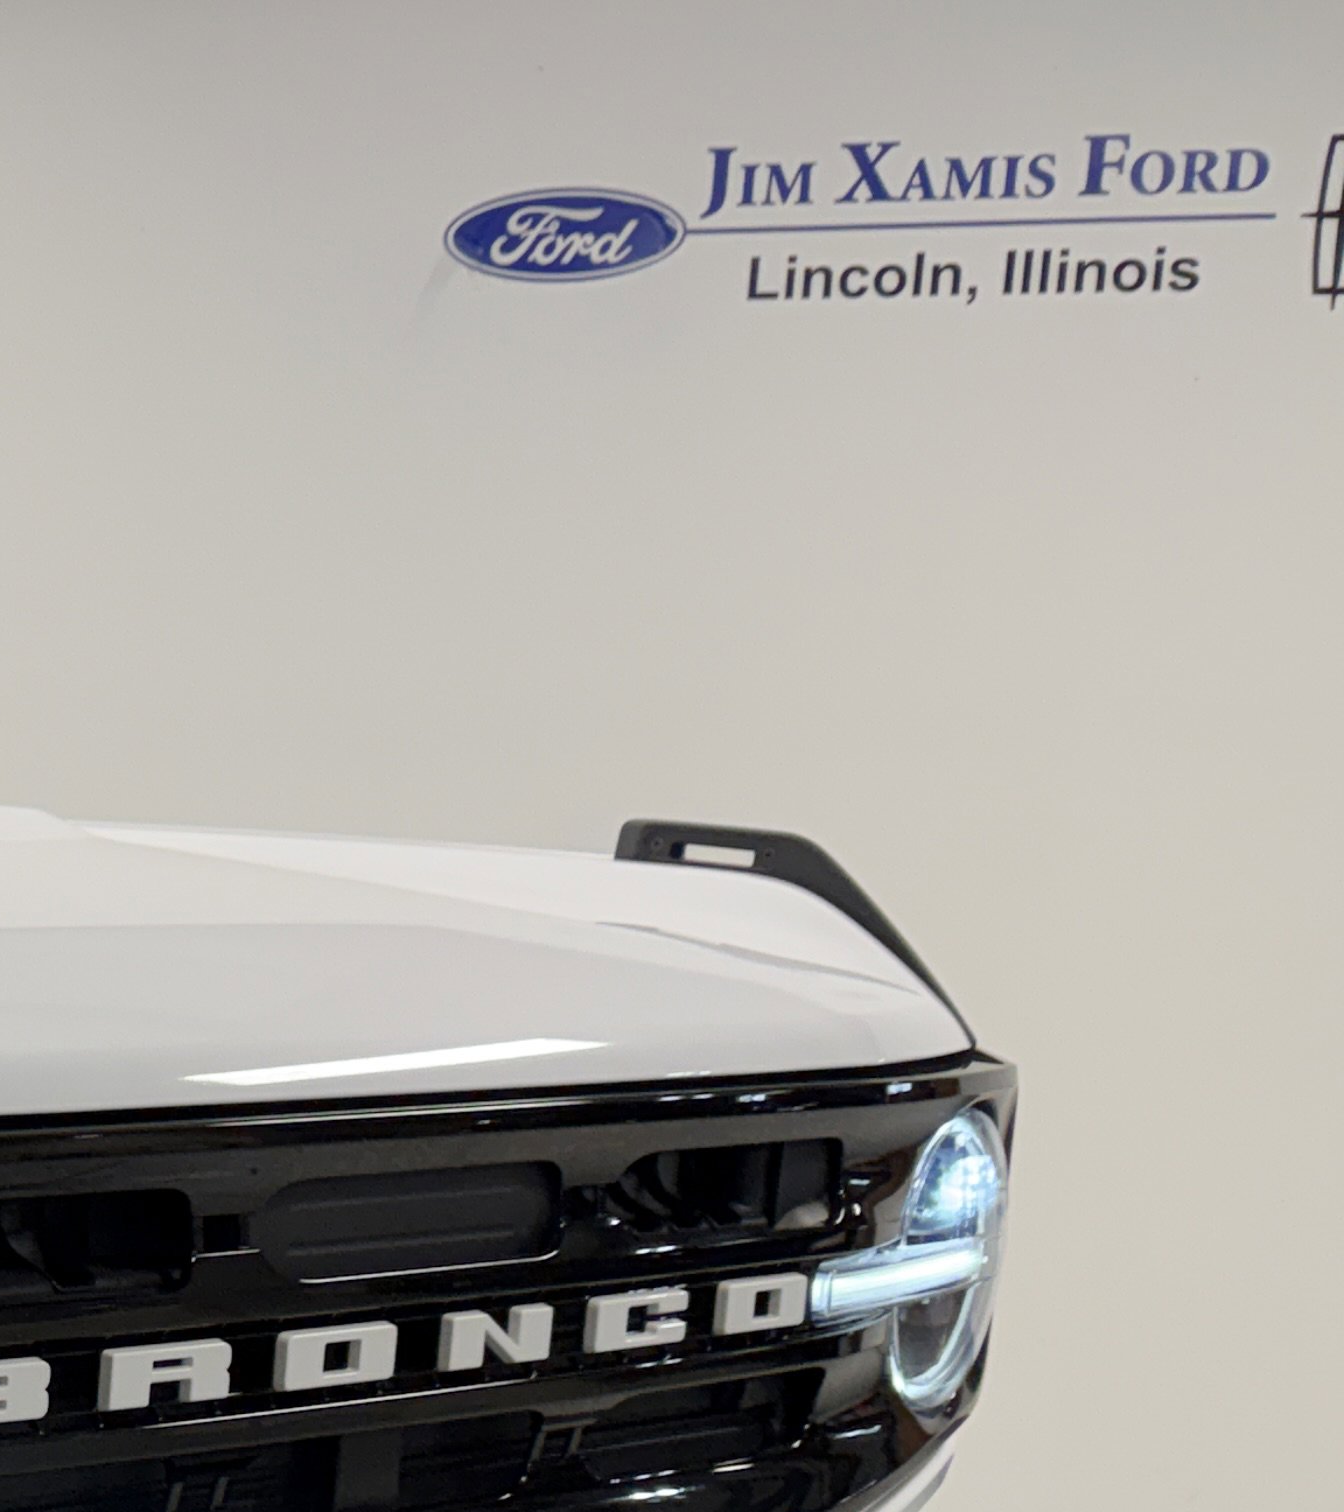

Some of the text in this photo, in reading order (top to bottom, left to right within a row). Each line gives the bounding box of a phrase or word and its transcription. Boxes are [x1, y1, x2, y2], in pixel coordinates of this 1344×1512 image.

[700, 133, 1271, 220] JIM XAMIS FORD
[489, 204, 640, 267] Ford
[746, 246, 1201, 306] Lincoln, Illinois
